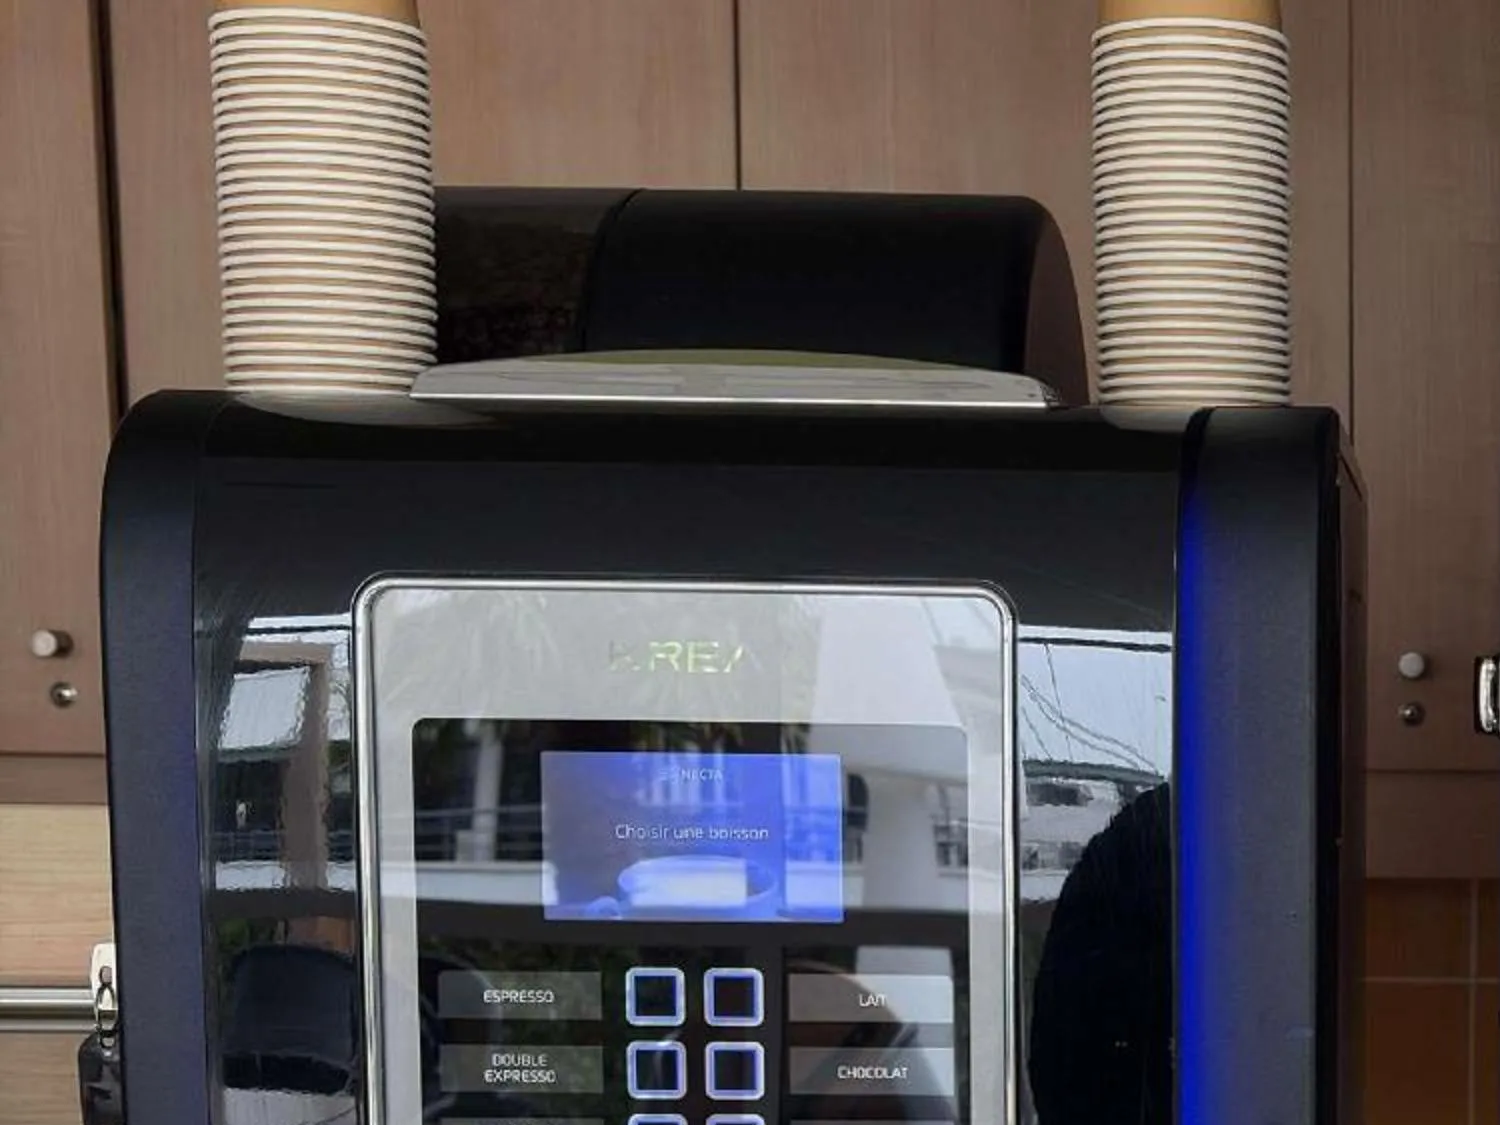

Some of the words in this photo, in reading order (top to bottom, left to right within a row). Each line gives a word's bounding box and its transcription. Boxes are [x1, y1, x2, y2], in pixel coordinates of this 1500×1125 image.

[615, 823, 668, 839] Choisir
[673, 828, 704, 839] une
[708, 824, 769, 840] boisson
[483, 989, 555, 1003] ESPRESSO
[492, 1053, 548, 1067] DOUBLE
[484, 1069, 556, 1084] EXPRESSO
[837, 1065, 908, 1080] CHOCOLAT
